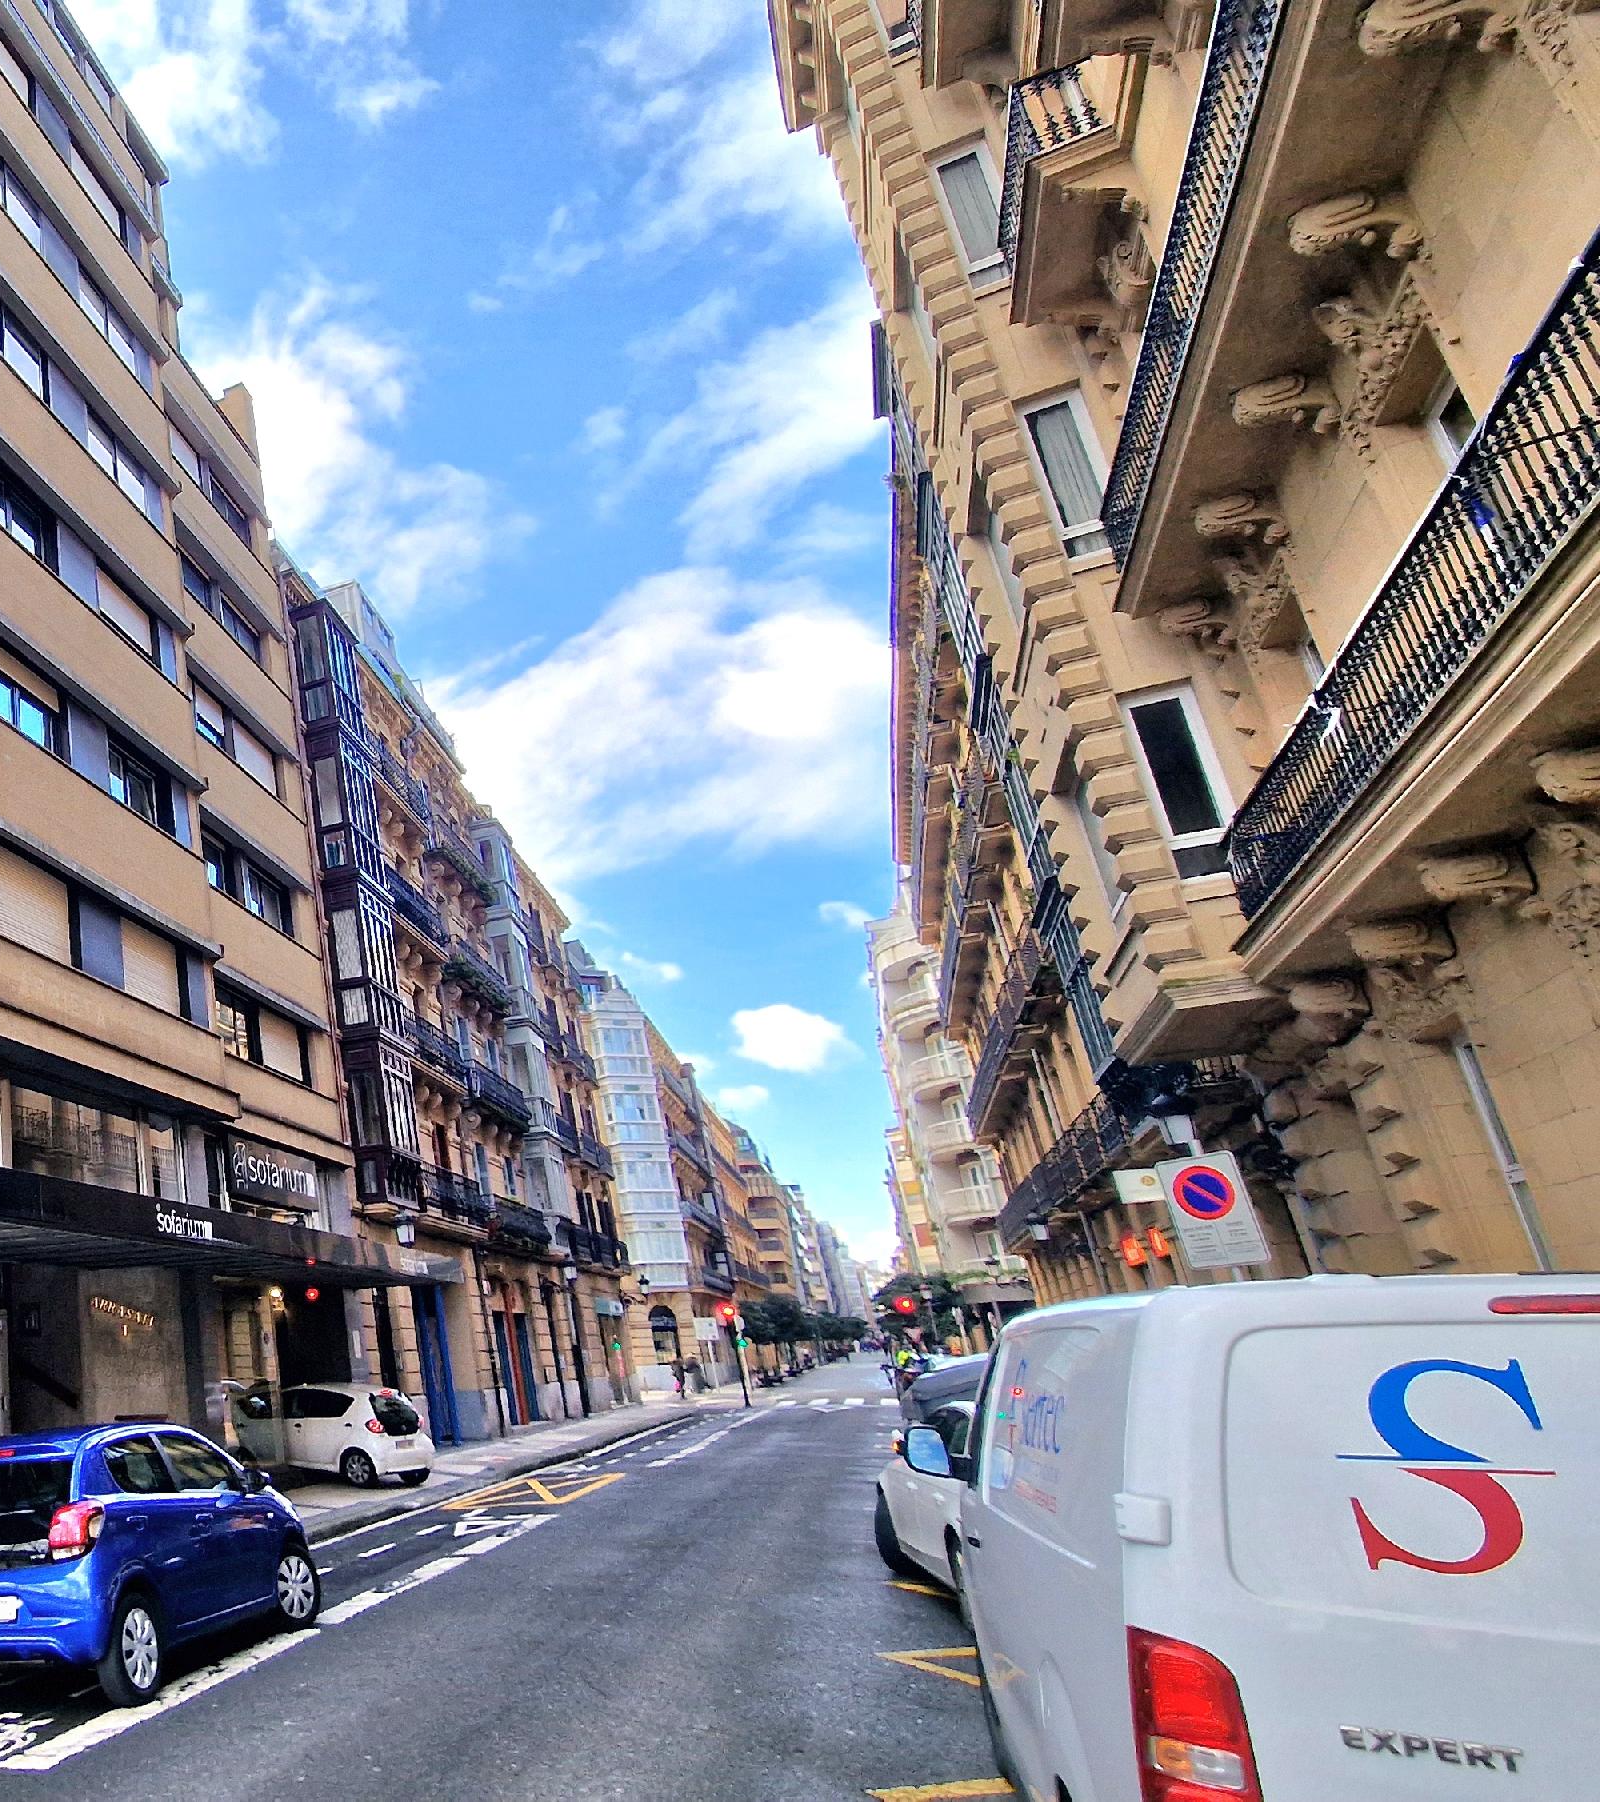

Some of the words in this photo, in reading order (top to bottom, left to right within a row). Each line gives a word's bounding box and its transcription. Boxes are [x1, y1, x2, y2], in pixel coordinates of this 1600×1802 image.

[247, 1153, 307, 1195] sofarium
[156, 1209, 206, 1238] sofarium
[1338, 1724, 1524, 1773] EXPERT
